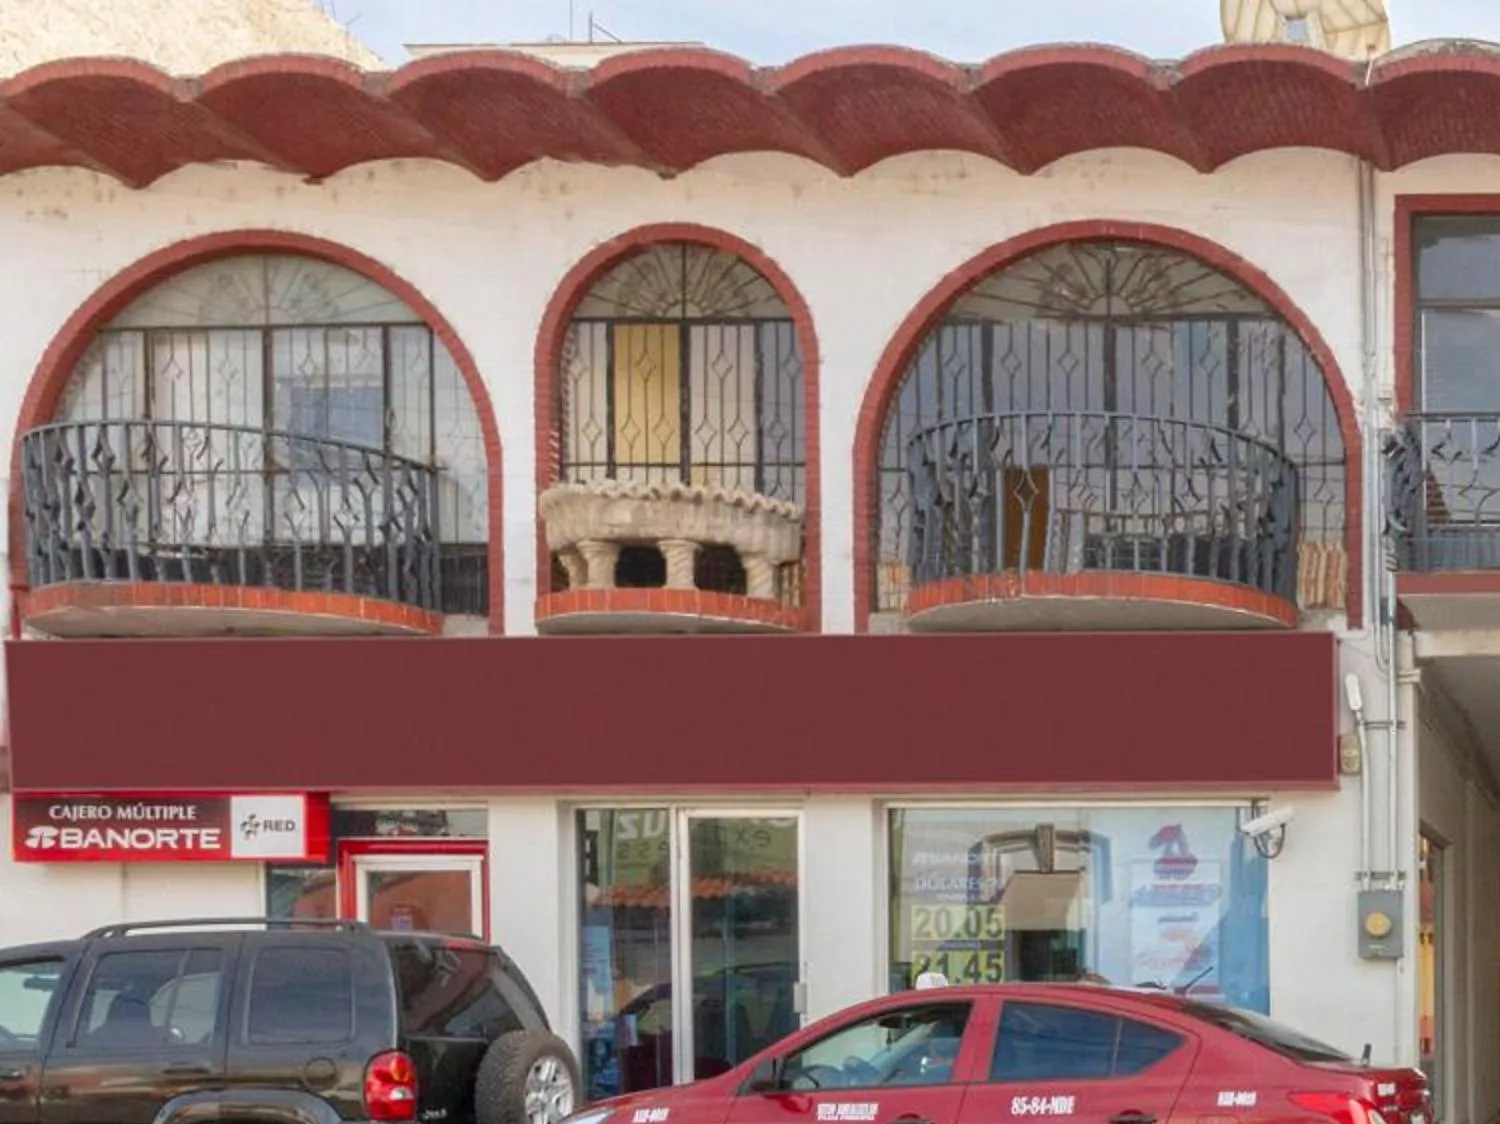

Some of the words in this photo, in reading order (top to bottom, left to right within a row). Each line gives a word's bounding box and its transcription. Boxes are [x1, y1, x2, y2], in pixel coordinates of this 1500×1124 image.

[48, 804, 113, 821] CAJERO
[117, 802, 197, 820] MÚLTIPLE
[263, 819, 296, 832] RED
[60, 827, 221, 849] BANORTE
[914, 906, 1003, 938] 20.05
